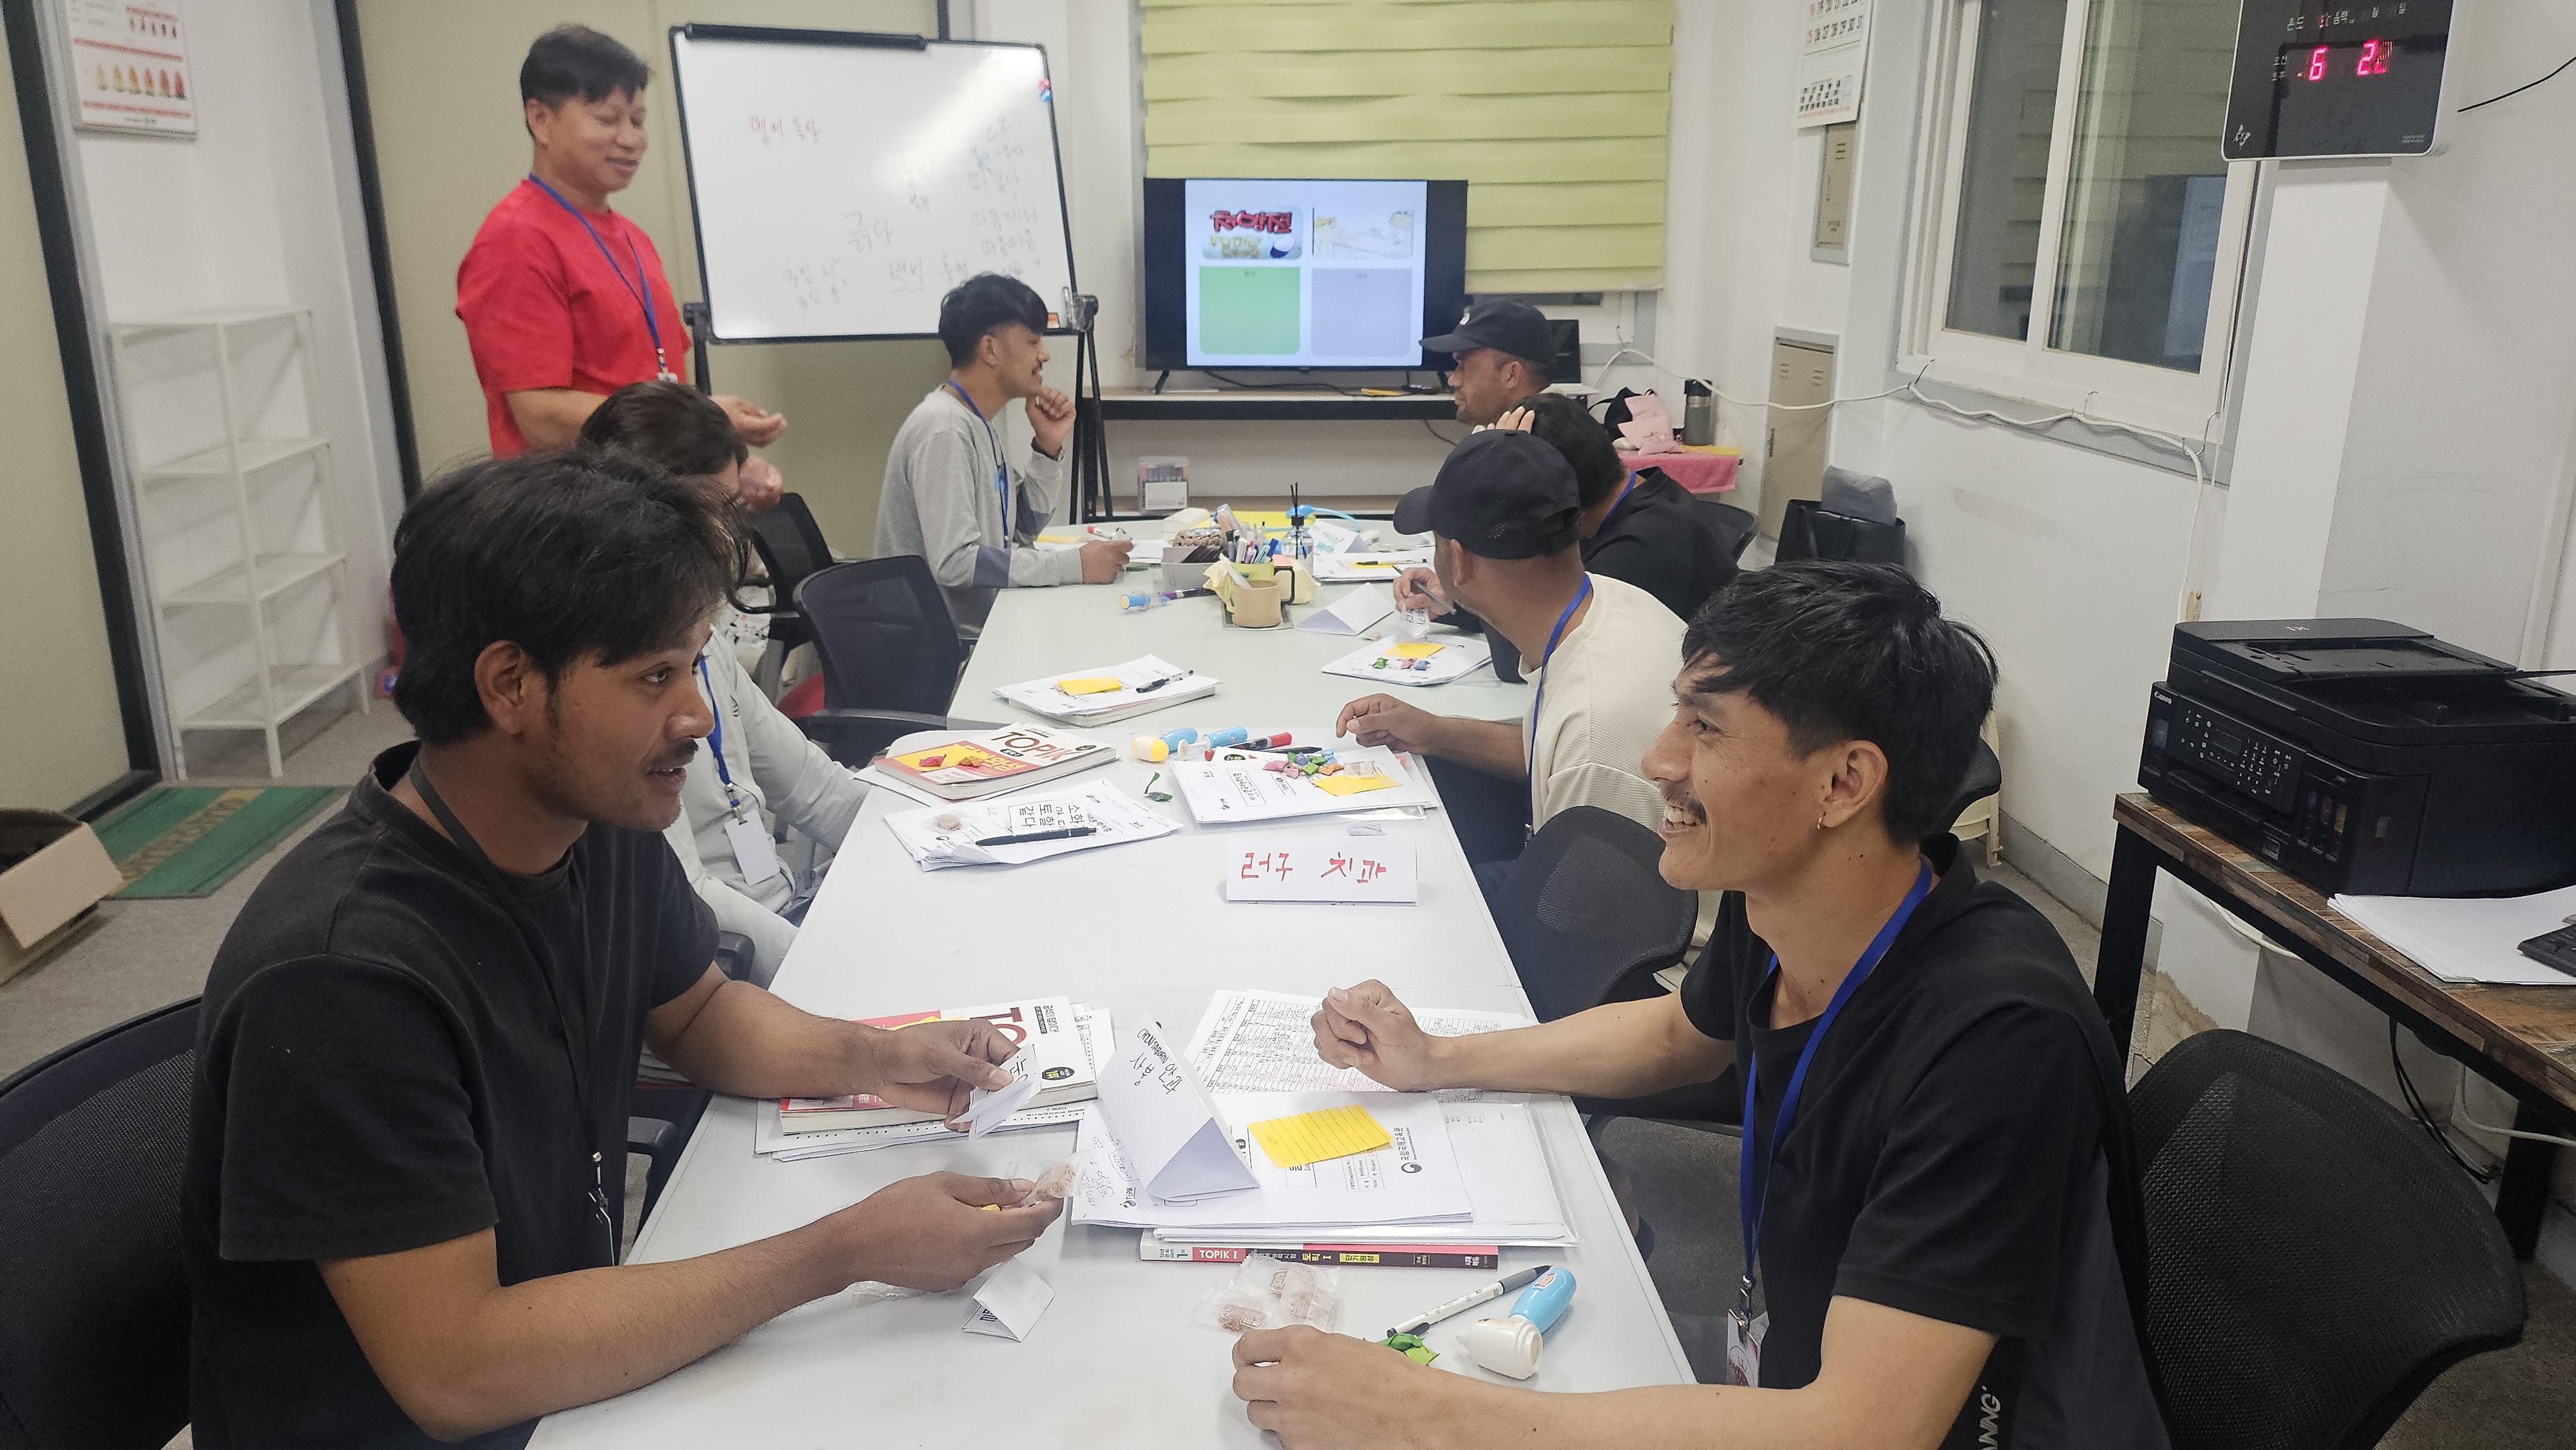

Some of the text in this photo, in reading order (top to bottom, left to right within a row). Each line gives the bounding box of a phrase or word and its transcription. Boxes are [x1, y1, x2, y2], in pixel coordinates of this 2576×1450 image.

[2309, 44, 2329, 81] 6
[2154, 691, 2172, 704] Canon
[990, 731, 1084, 761] TOPIK
[1019, 806, 1036, 827] 같다
[1039, 804, 1055, 826] 토할
[1320, 851, 1387, 884] 치과
[1393, 1127, 1410, 1161] 국립국제교육원
[1199, 1250, 1238, 1260] TOPIK I
[1302, 1253, 1320, 1262] 토픽
